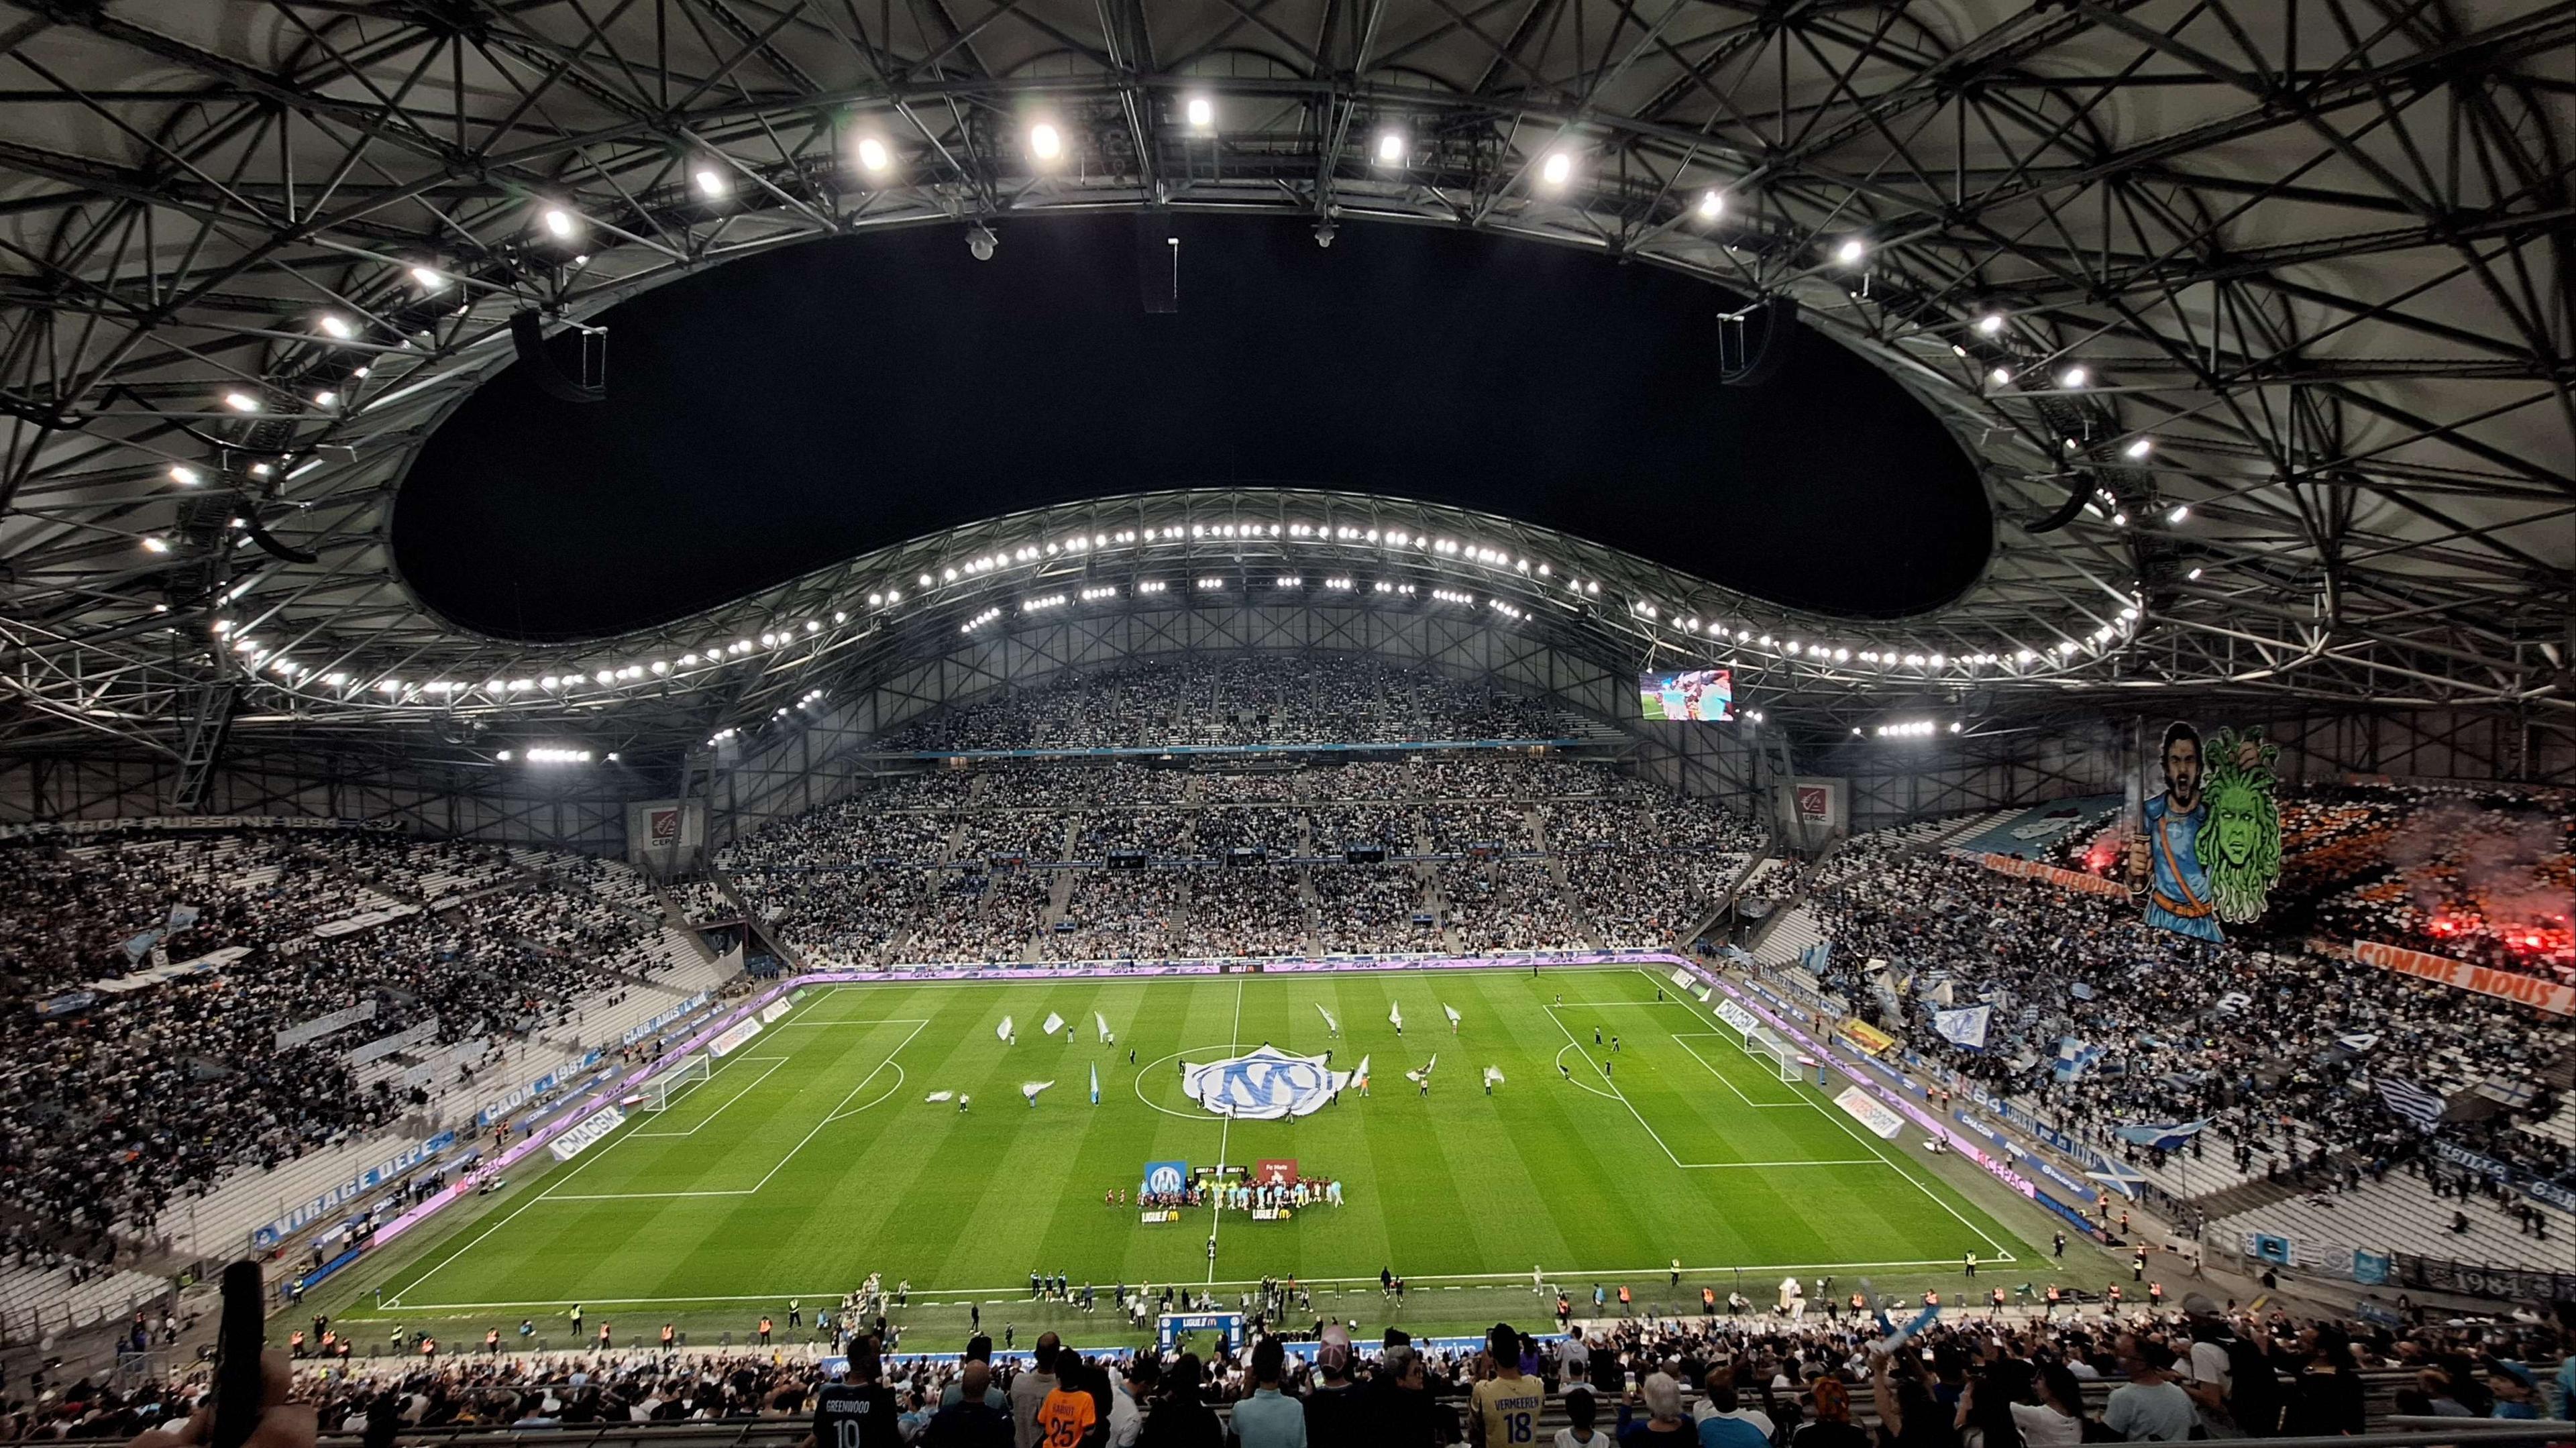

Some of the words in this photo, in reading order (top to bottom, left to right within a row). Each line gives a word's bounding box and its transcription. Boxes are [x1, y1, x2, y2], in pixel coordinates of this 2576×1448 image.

[140, 816, 274, 830] PUISSANT
[282, 816, 336, 829] 1994
[2356, 942, 2463, 984] COMME
[2467, 968, 2559, 1007] NOUS
[623, 1021, 651, 1045] CLUB
[655, 1007, 680, 1028] AMIS
[484, 1087, 535, 1121] CAOM
[551, 1054, 586, 1083] 1987
[1985, 1154, 2027, 1193] CEPAC
[273, 1172, 374, 1236] VIRAGE
[1142, 1211, 1163, 1223] LIGUE
[1252, 1209, 1273, 1220] LIGUE
[1183, 1318, 1201, 1327] LIGUE
[826, 1400, 870, 1414] GREENWOOD
[1495, 1396, 1540, 1410] VERMEEREN
[833, 1418, 861, 1448] 10
[1051, 1416, 1075, 1447] 25
[1503, 1412, 1532, 1445] 18
